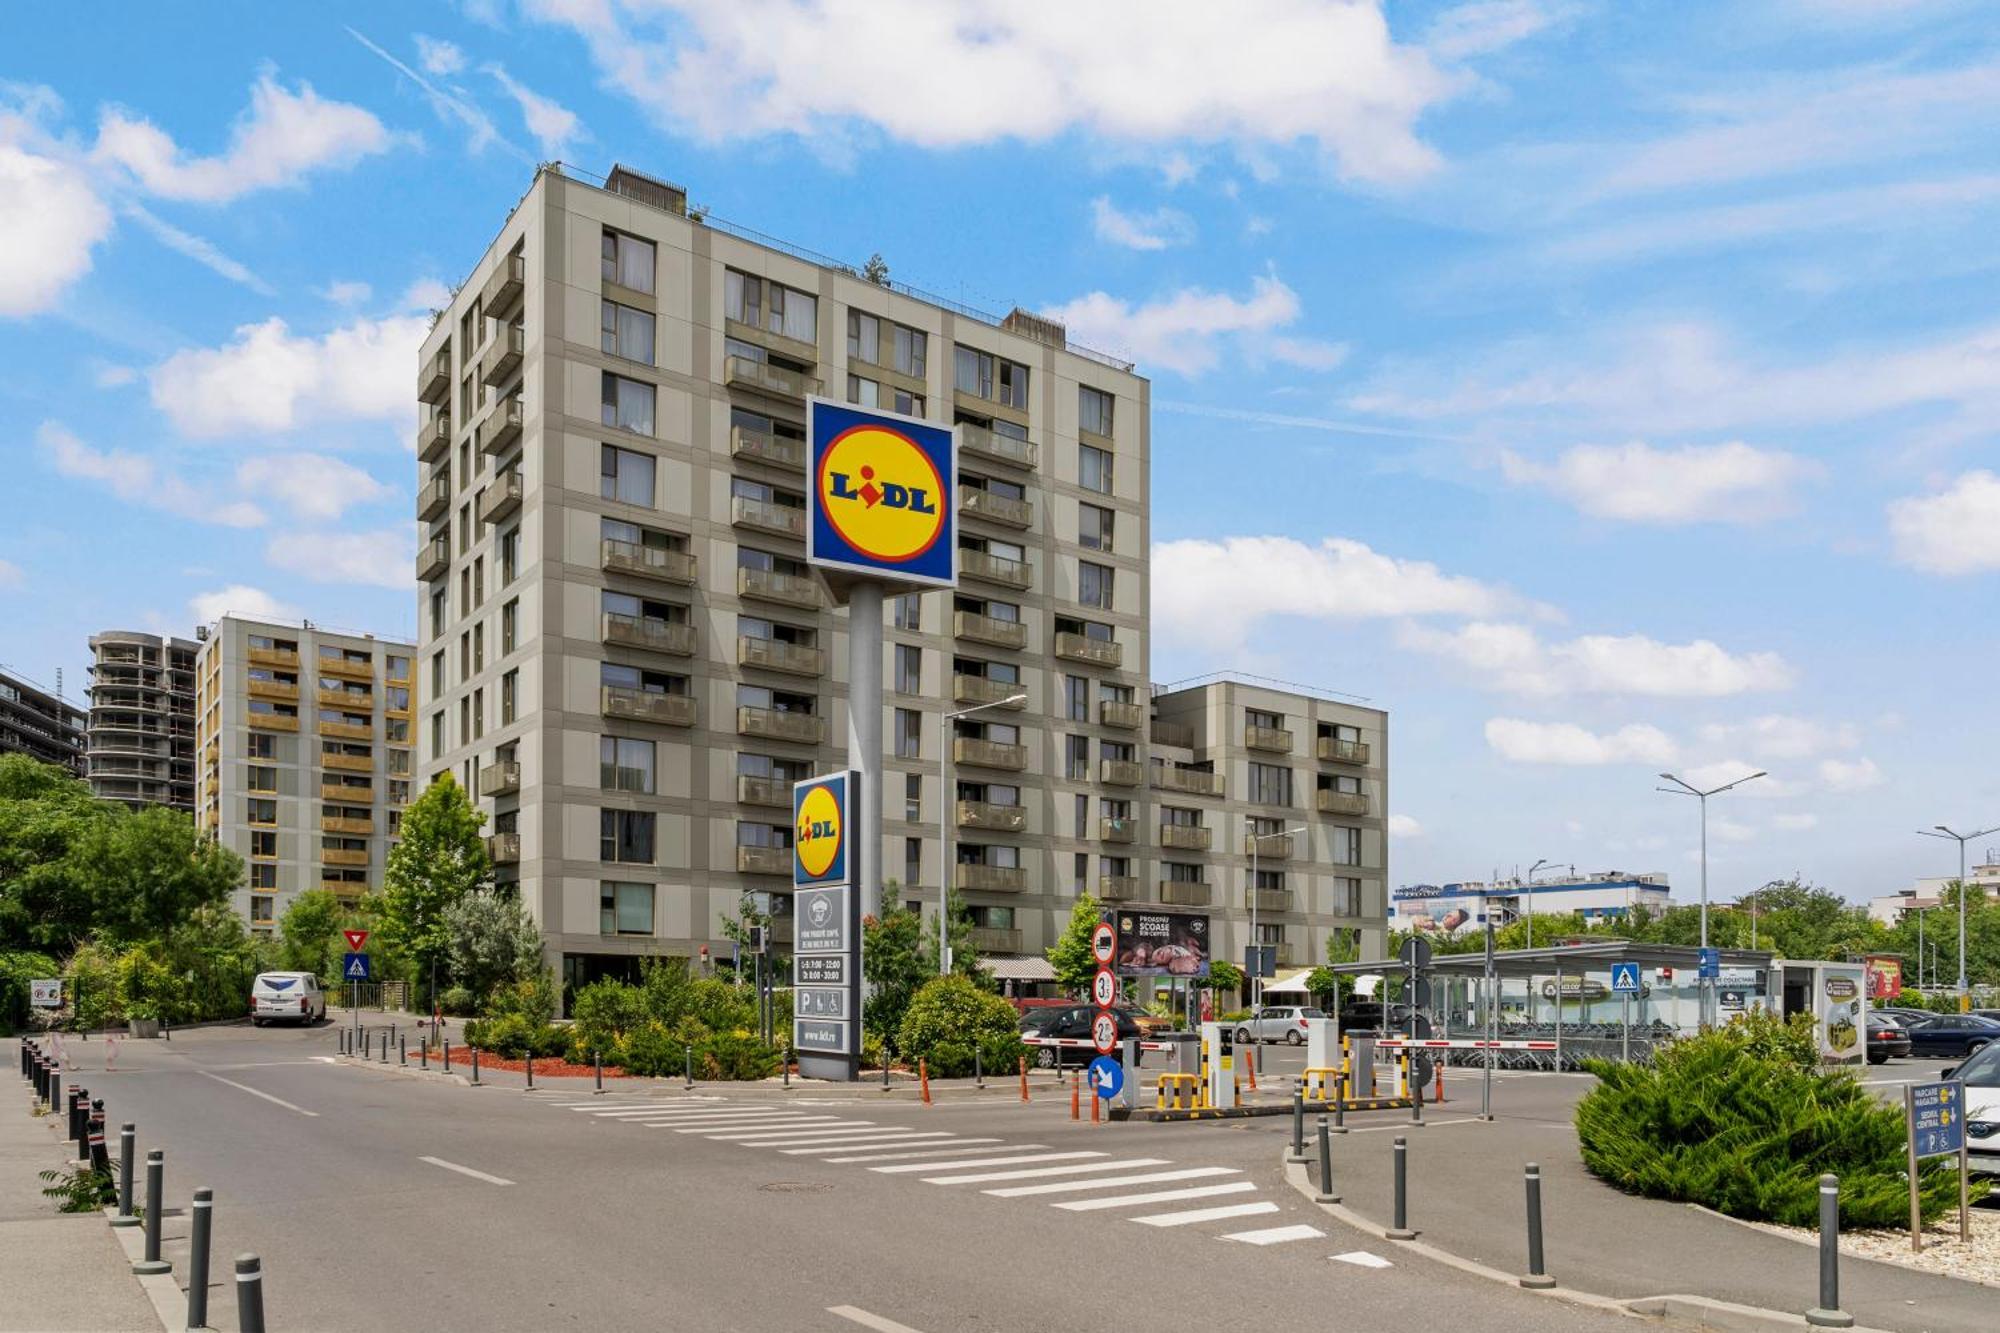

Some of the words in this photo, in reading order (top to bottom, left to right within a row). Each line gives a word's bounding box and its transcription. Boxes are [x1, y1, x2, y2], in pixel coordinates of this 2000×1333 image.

[830, 465, 935, 514] LIDL
[798, 816, 835, 844] LIDL
[1139, 923, 1170, 931] SCOASE
